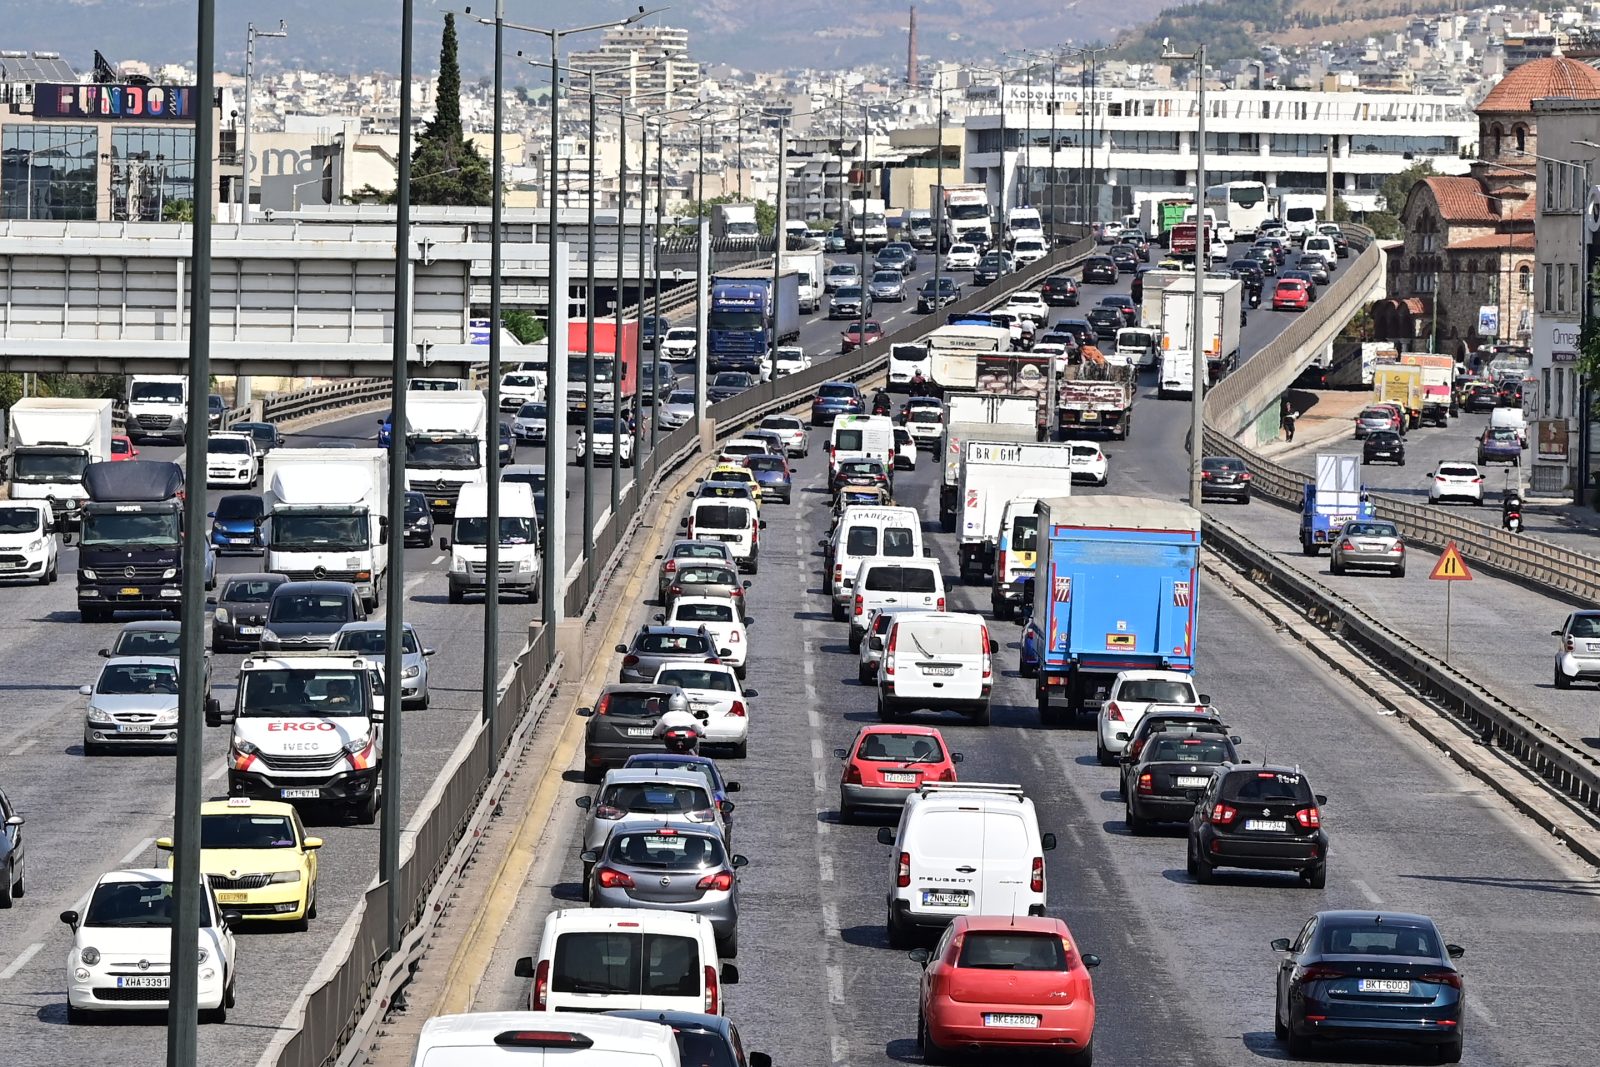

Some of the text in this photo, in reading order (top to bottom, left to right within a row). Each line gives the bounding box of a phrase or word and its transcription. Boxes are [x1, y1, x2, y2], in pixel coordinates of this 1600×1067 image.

[1523, 391, 1538, 418] 54
[267, 721, 337, 733] ERGO
[283, 742, 320, 751] IVECO
[929, 893, 968, 903] ZNN-9424
[125, 977, 168, 987] XHA-3391
[1365, 979, 1409, 990] BKT-6003
